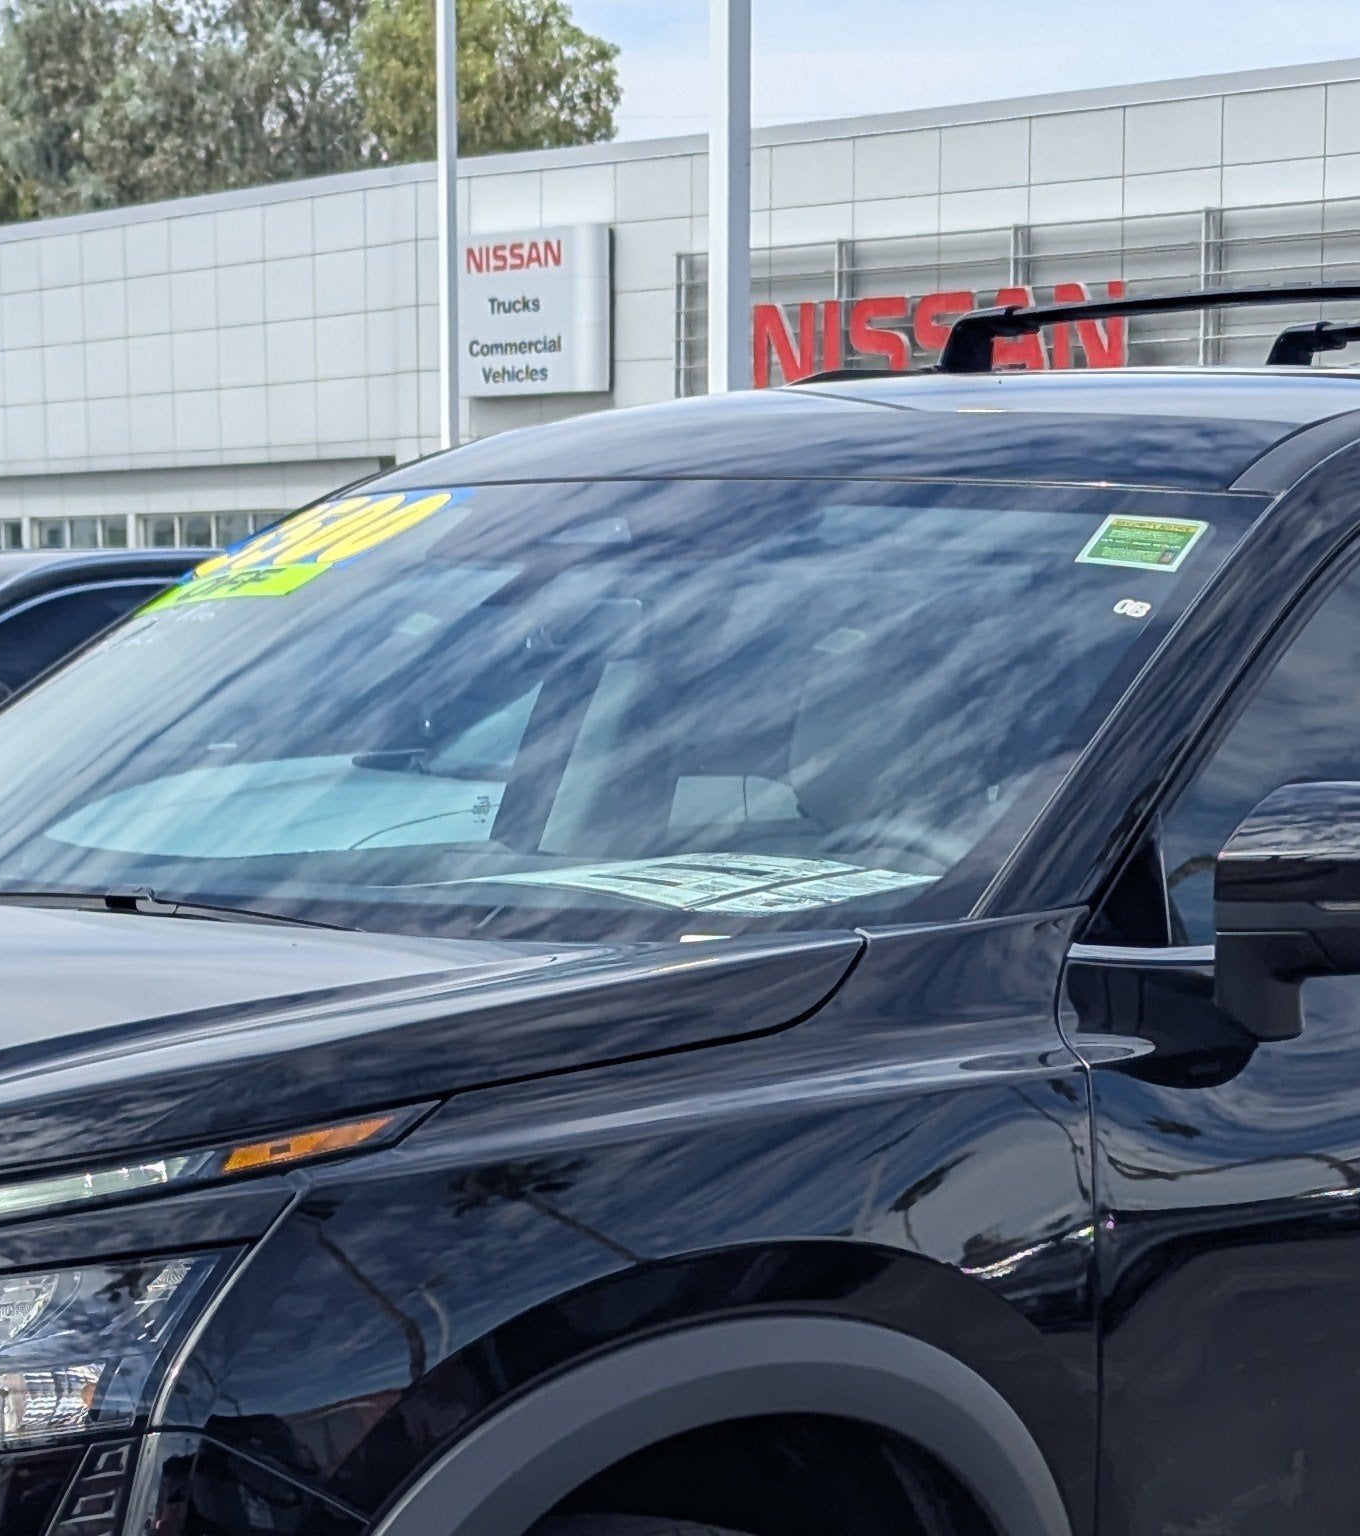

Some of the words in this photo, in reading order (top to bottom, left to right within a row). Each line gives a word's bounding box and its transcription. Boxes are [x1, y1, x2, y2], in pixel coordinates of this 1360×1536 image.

[465, 240, 562, 274] NISSAN
[489, 295, 541, 315] Trucks
[468, 335, 563, 358] Commercial
[481, 365, 549, 384] Vehicles
